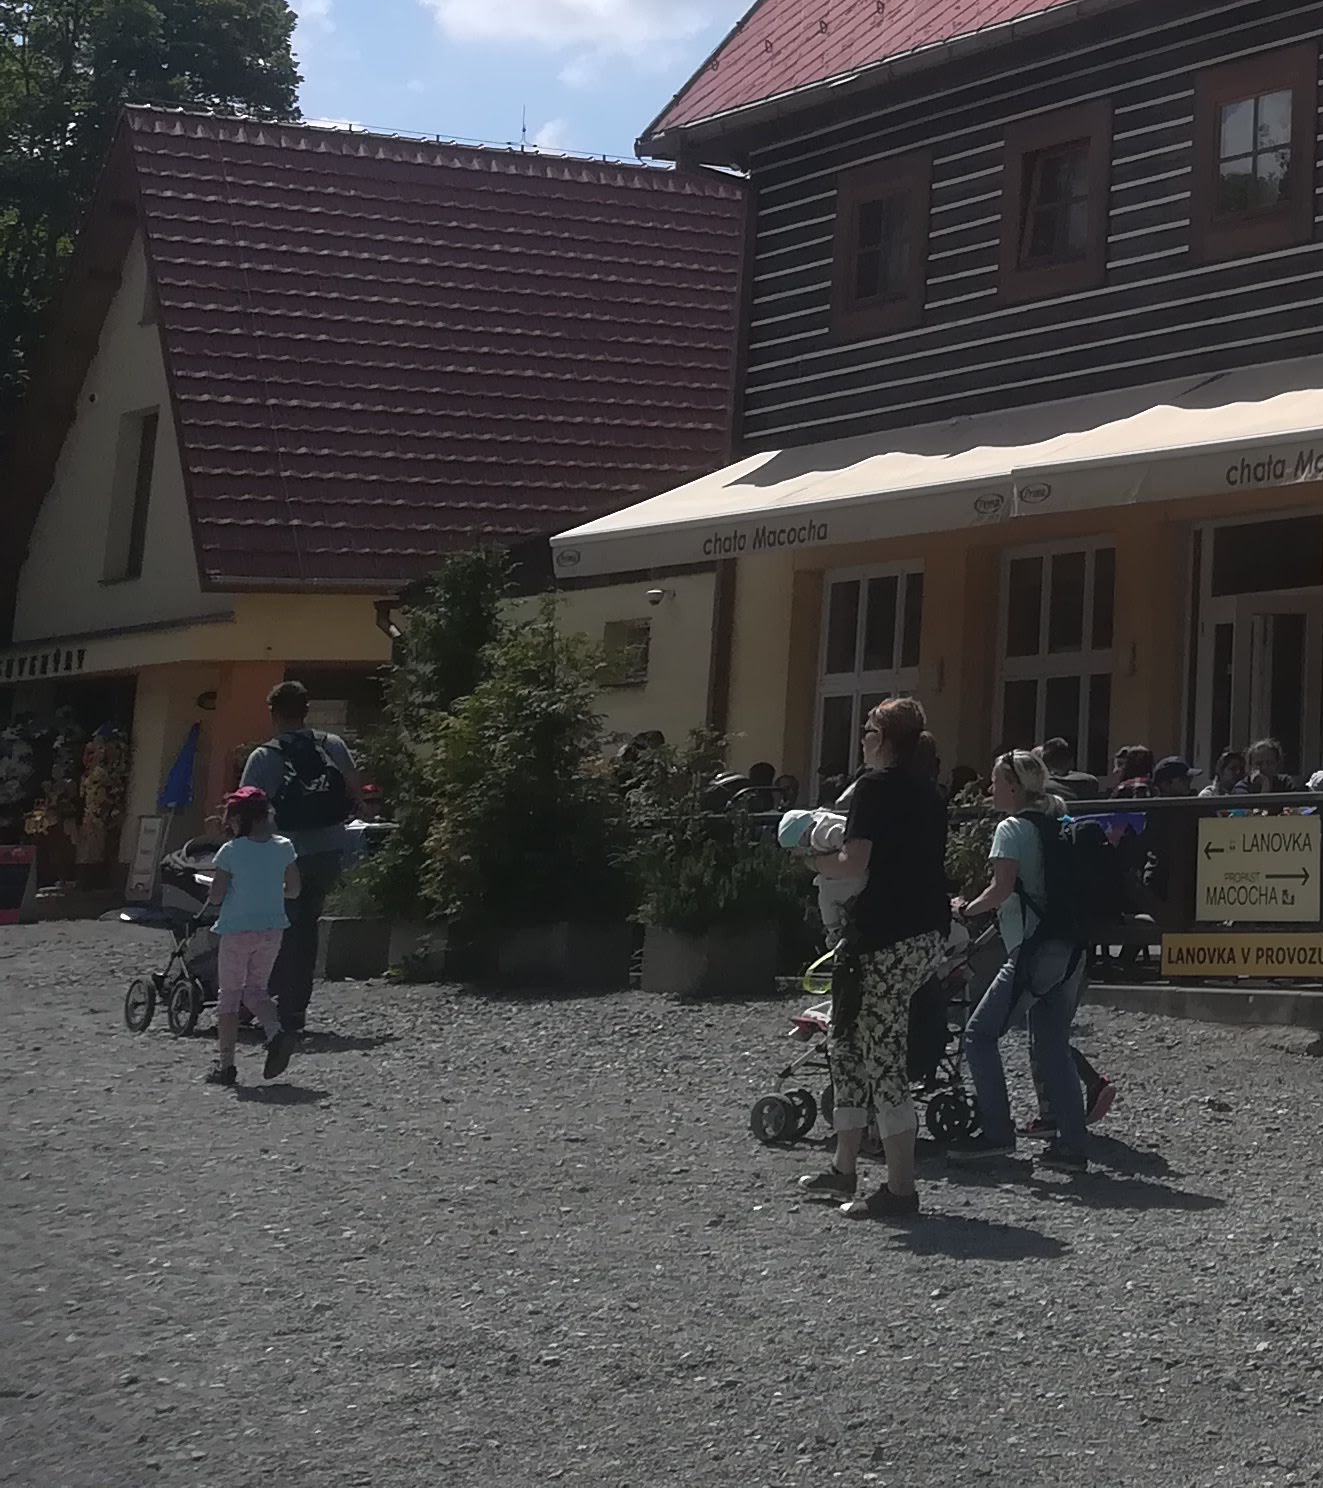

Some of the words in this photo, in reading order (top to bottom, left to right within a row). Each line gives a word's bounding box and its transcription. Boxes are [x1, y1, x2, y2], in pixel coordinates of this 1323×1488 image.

[1226, 454, 1286, 486] chata
[703, 530, 746, 556] chata
[752, 520, 828, 550] Macocha
[1242, 833, 1312, 853] LANOVKA
[1206, 886, 1278, 906] MACOCHA
[1167, 947, 1236, 965] LANOVKA
[1241, 947, 1250, 964] V
